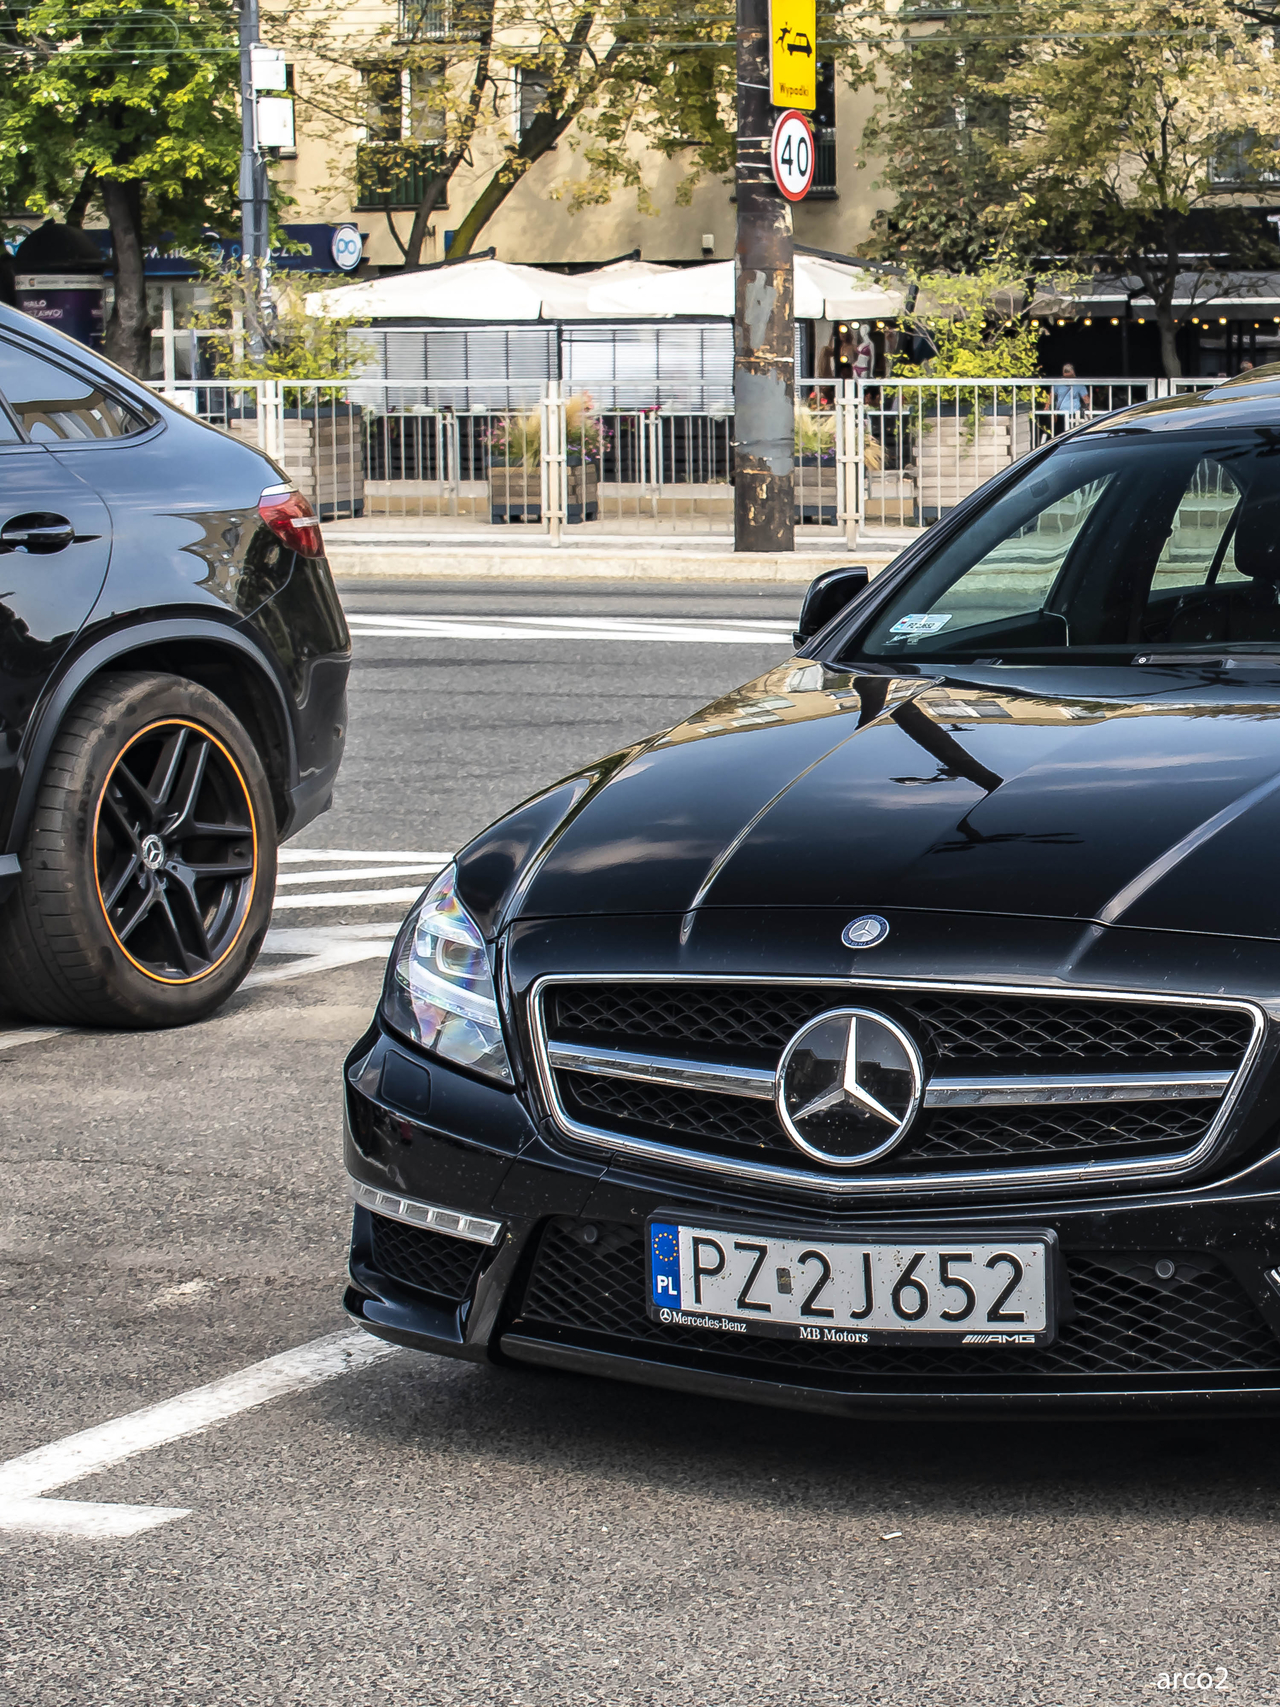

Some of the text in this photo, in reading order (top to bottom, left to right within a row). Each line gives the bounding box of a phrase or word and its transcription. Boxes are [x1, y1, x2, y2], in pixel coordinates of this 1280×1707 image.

[778, 82, 810, 98] Wypadki
[780, 134, 809, 178] 40
[657, 1275, 678, 1296] PL
[692, 1235, 1026, 1323] PZ 2J652
[672, 1311, 747, 1333] Mercedes-Benz
[799, 1326, 869, 1343] MB Motors
[984, 1334, 1036, 1344] AMG
